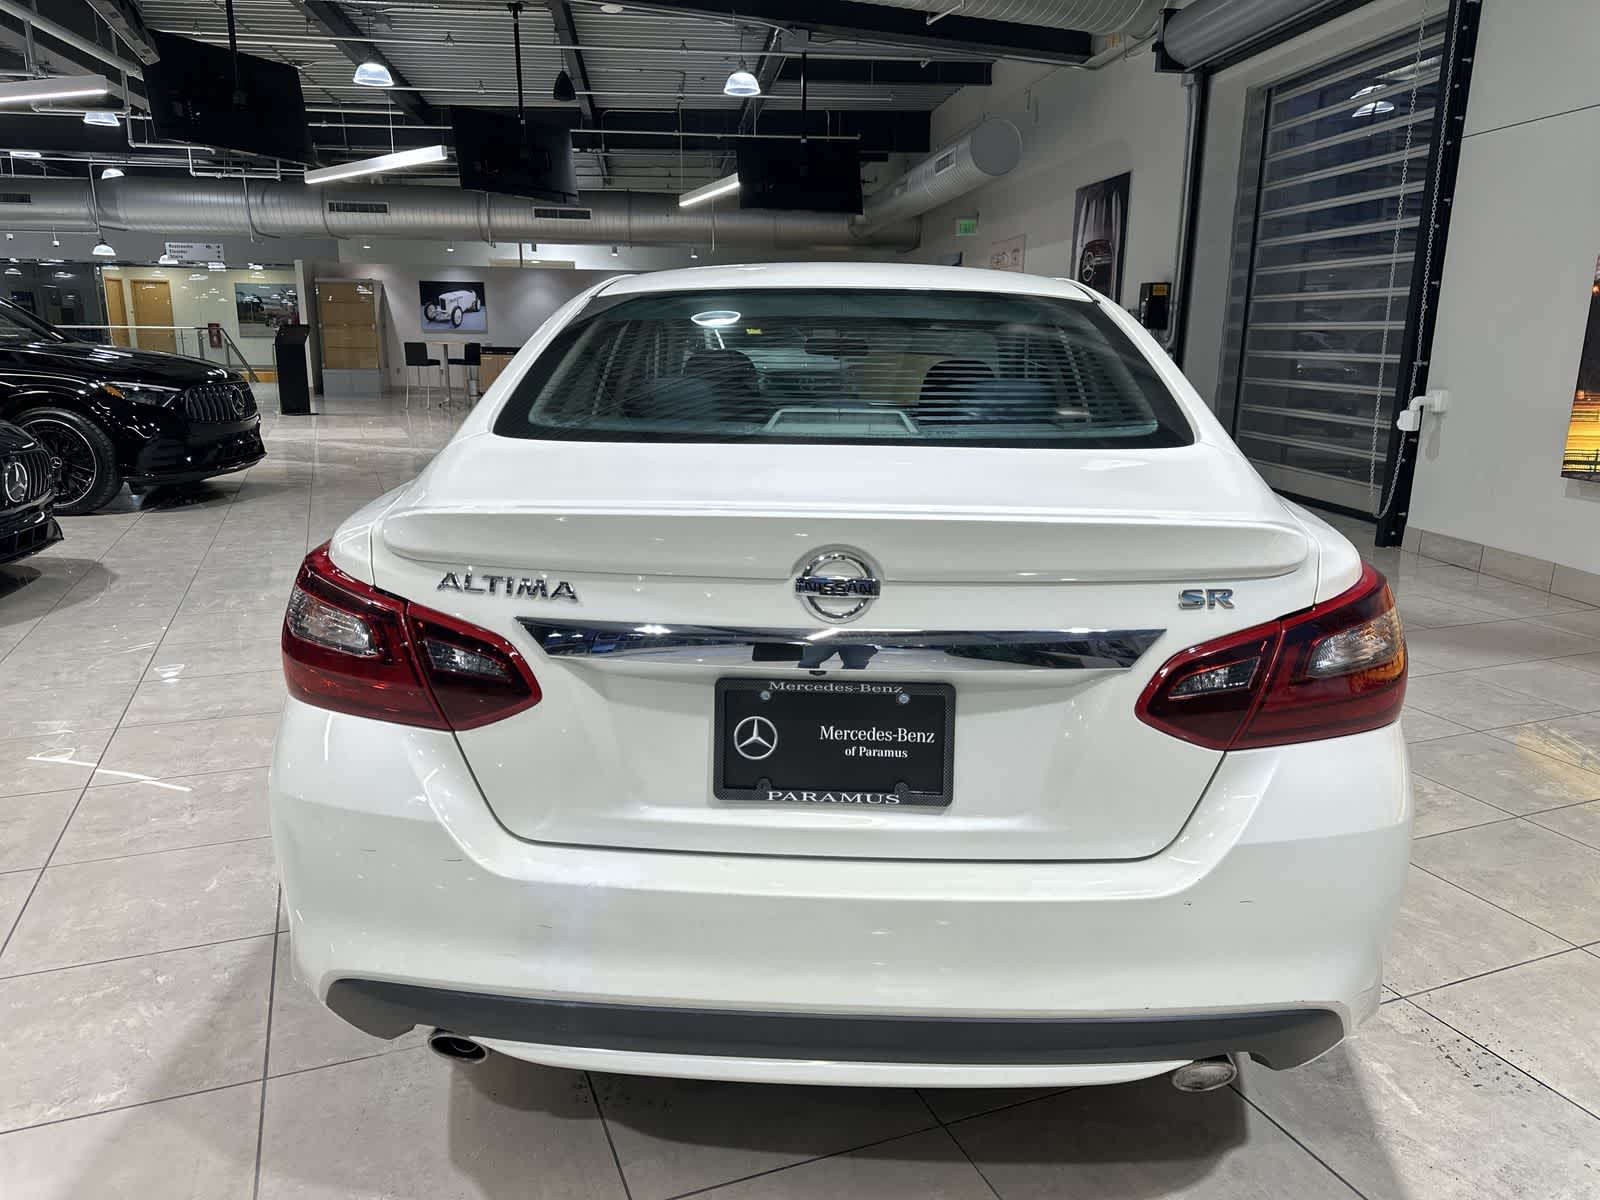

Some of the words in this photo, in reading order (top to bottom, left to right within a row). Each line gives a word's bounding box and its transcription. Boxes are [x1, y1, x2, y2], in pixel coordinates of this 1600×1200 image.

[437, 571, 578, 602] ALTIMA
[803, 581, 873, 595] NISSAN
[1179, 588, 1234, 609] SR
[769, 681, 903, 694] Mercedes-Benz
[819, 725, 936, 744] Mercedes-Benz
[845, 746, 856, 757] of
[859, 746, 909, 758] Paramus
[768, 791, 901, 804] PARAMUS
